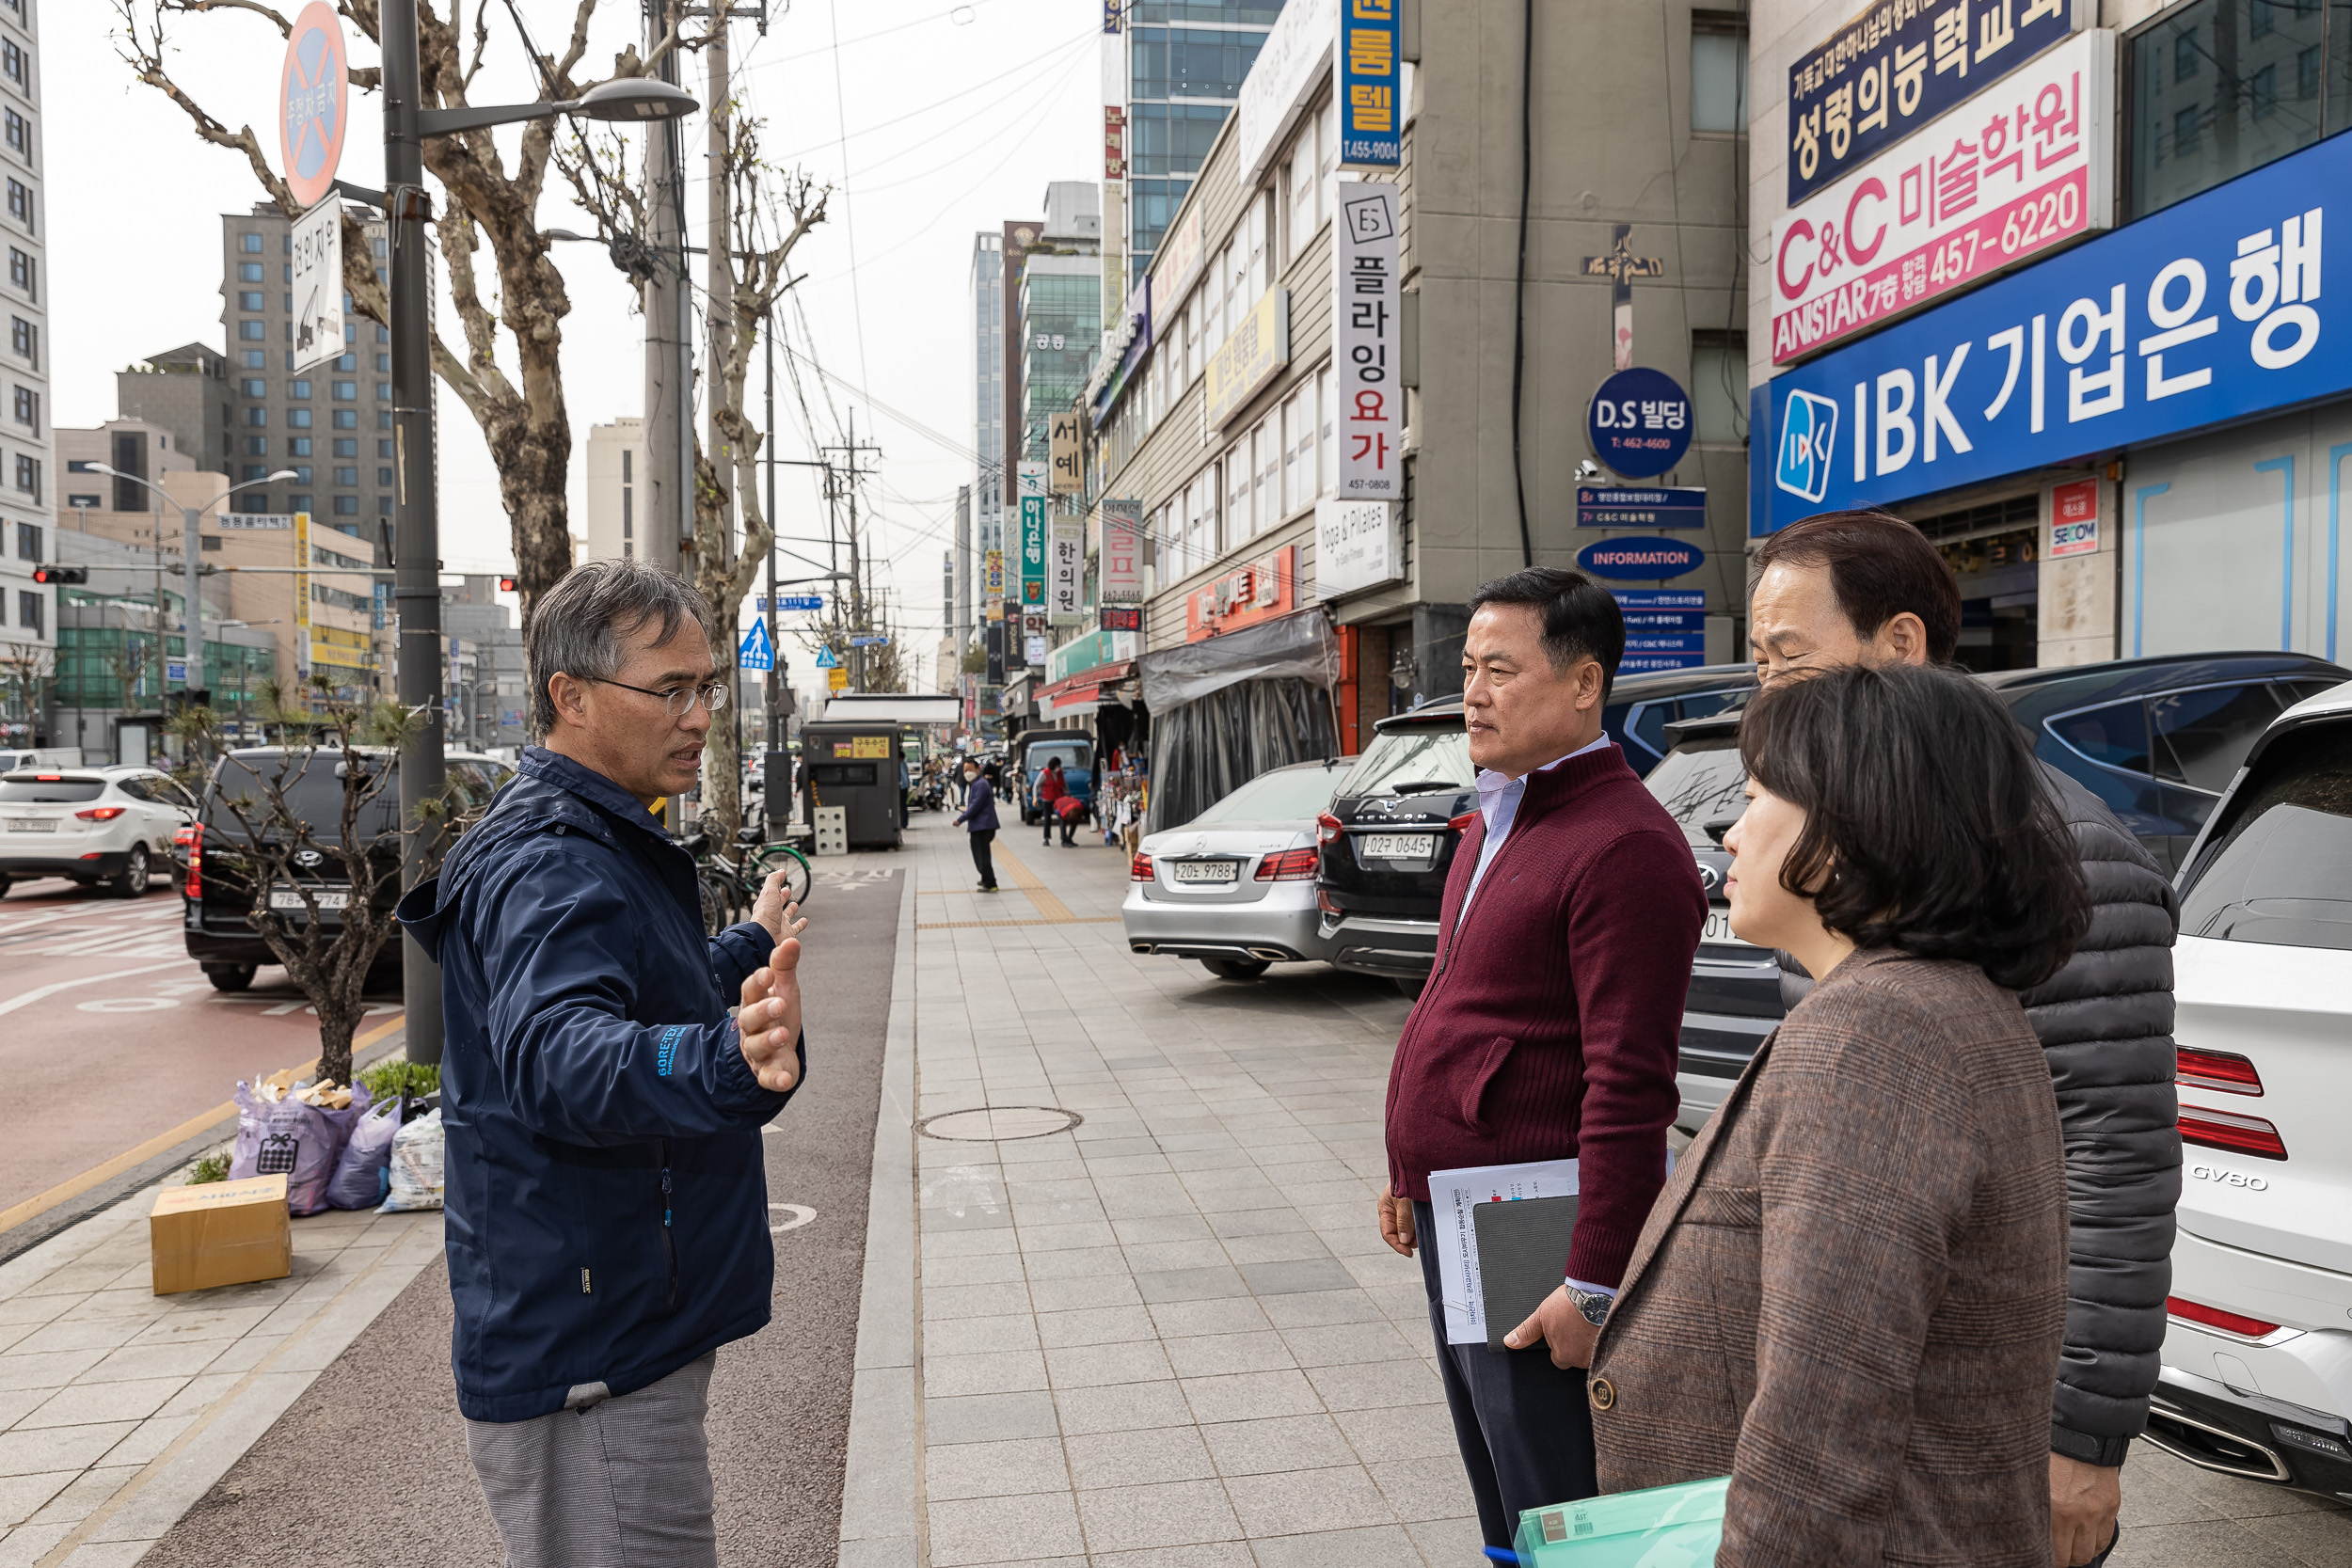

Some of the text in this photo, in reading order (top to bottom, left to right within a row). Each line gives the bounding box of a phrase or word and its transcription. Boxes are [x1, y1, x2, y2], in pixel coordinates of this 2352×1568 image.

[287, 75, 337, 128] 주정차금지
[1105, 108, 1121, 176] 노래방
[1343, 140, 1398, 160] T.455-9004
[1777, 71, 2080, 300] C&C 미술학원
[294, 218, 337, 279] 견인지역
[1774, 277, 1867, 358] ANISTAR
[1868, 273, 1899, 316] 7층
[1930, 182, 2080, 285] 457-6220
[1853, 207, 2324, 483] IBK 기업은행
[1597, 400, 1685, 430] D.S 빌딩
[1054, 419, 1078, 478] 서예
[1623, 437, 1671, 449] 462-4600
[1025, 499, 1041, 564] 하나은행
[1597, 513, 1618, 522] C&C
[1620, 513, 1655, 522] 미술학원
[2054, 522, 2095, 545] SECOM
[1594, 551, 1689, 564] INFORMATION
[1058, 542, 1076, 611] 한의원
[1026, 617, 1044, 634] 약
[856, 738, 886, 748] 구두수선
[1356, 812, 1428, 821] REXTON
[1371, 837, 1425, 853] 02구 0645
[1181, 863, 1231, 878] 20노 9788
[1706, 914, 1738, 939] 01
[658, 1026, 679, 1076] GORE-TEX
[667, 1037, 681, 1075] Performance
[2189, 1164, 2268, 1191] GV80
